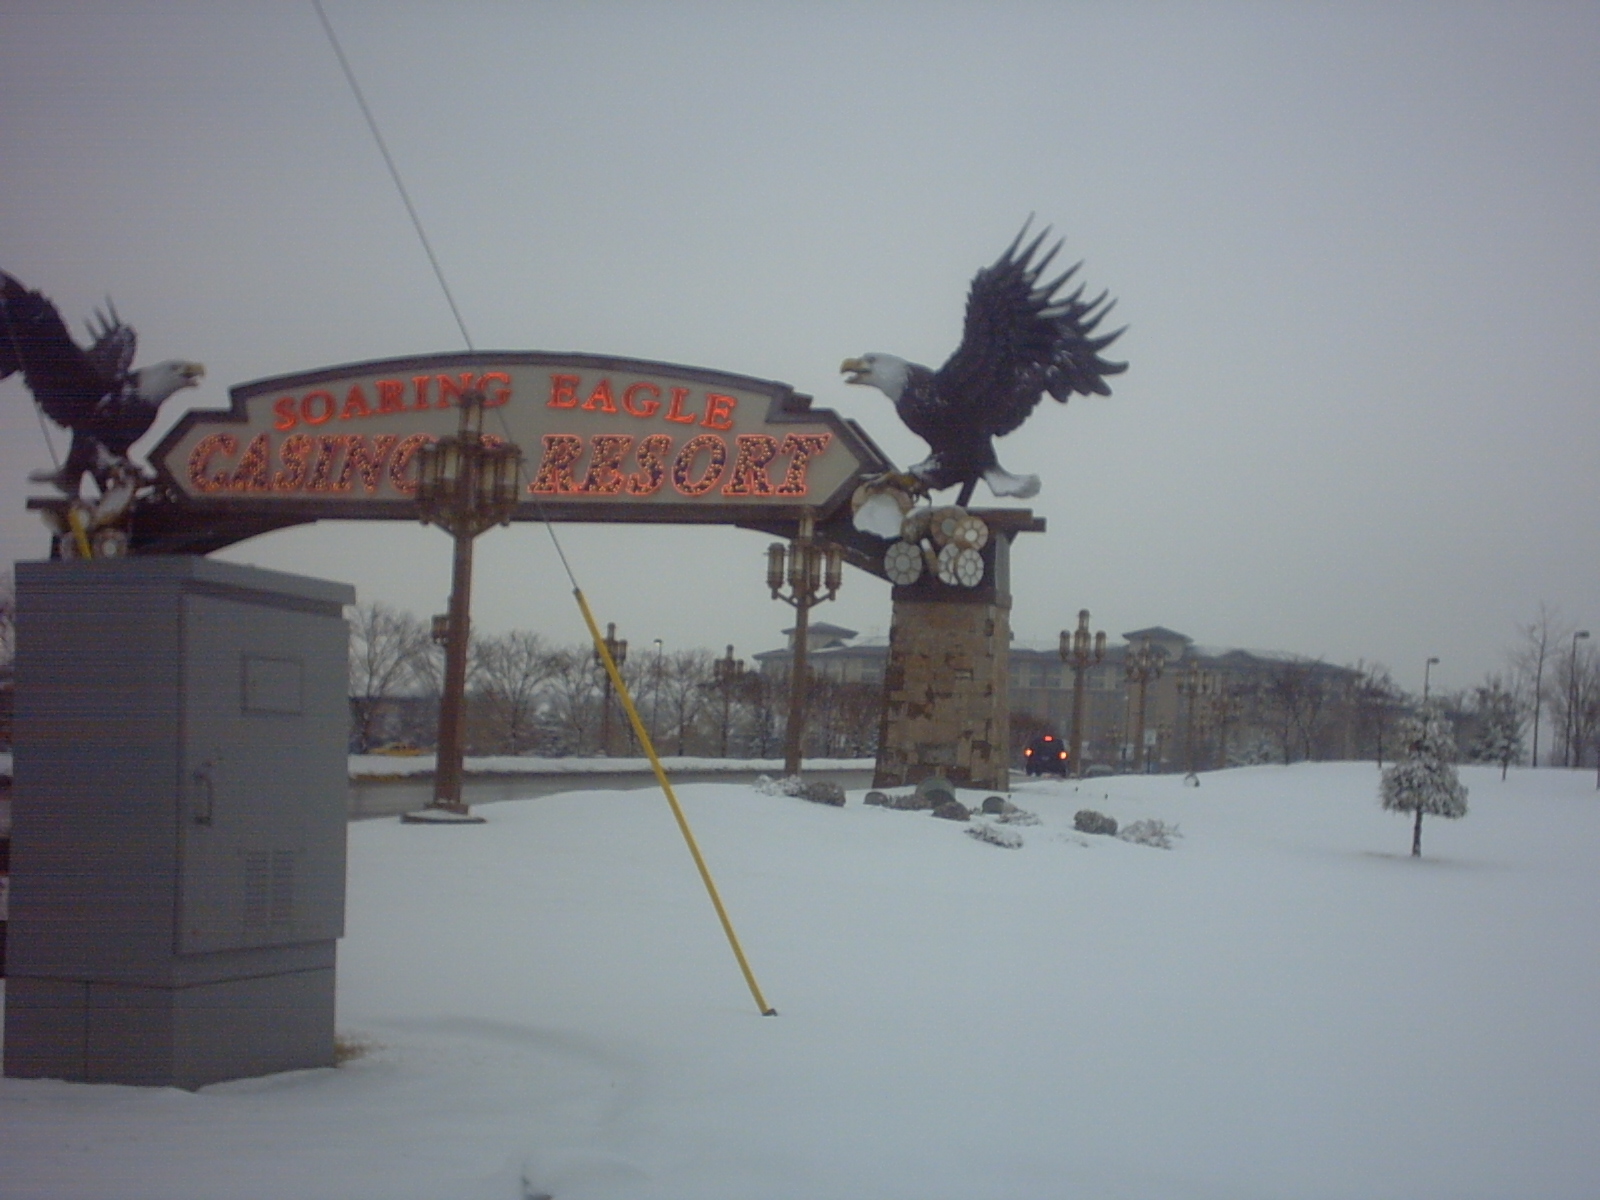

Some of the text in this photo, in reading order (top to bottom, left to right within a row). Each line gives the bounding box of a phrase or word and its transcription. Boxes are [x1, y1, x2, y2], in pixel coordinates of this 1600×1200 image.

[273, 372, 738, 431] SOARING EAGLE
[527, 432, 833, 496] RESORT
